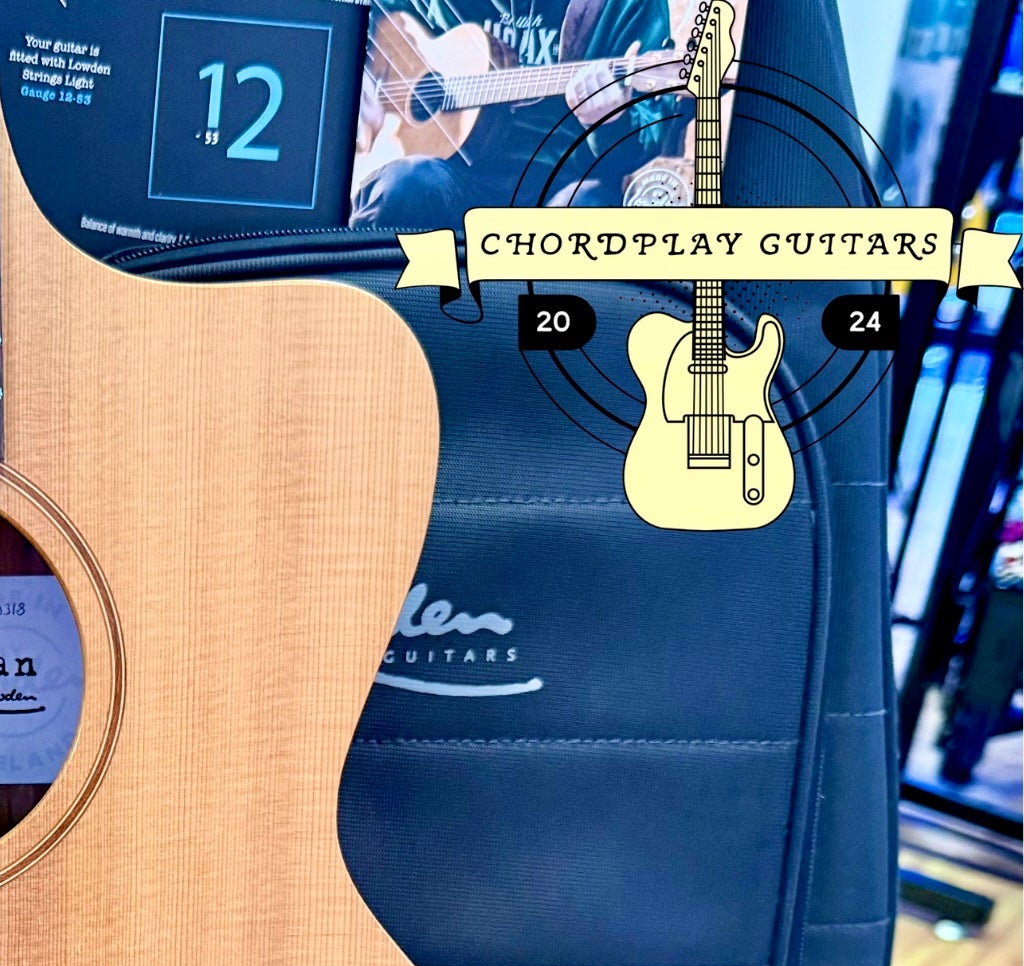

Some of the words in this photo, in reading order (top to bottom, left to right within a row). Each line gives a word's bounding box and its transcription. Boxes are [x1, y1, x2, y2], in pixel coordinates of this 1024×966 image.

[25, 34, 52, 50] Your
[53, 41, 88, 55] guitar
[89, 45, 100, 57] is
[9, 49, 39, 65] fitted
[41, 55, 66, 69] with
[68, 59, 111, 76] Lowden
[22, 68, 63, 86] Strings
[64, 74, 95, 90] Light
[21, 85, 56, 102] Gauge
[198, 62, 284, 162] 12
[383, 647, 519, 664] GUITARS
